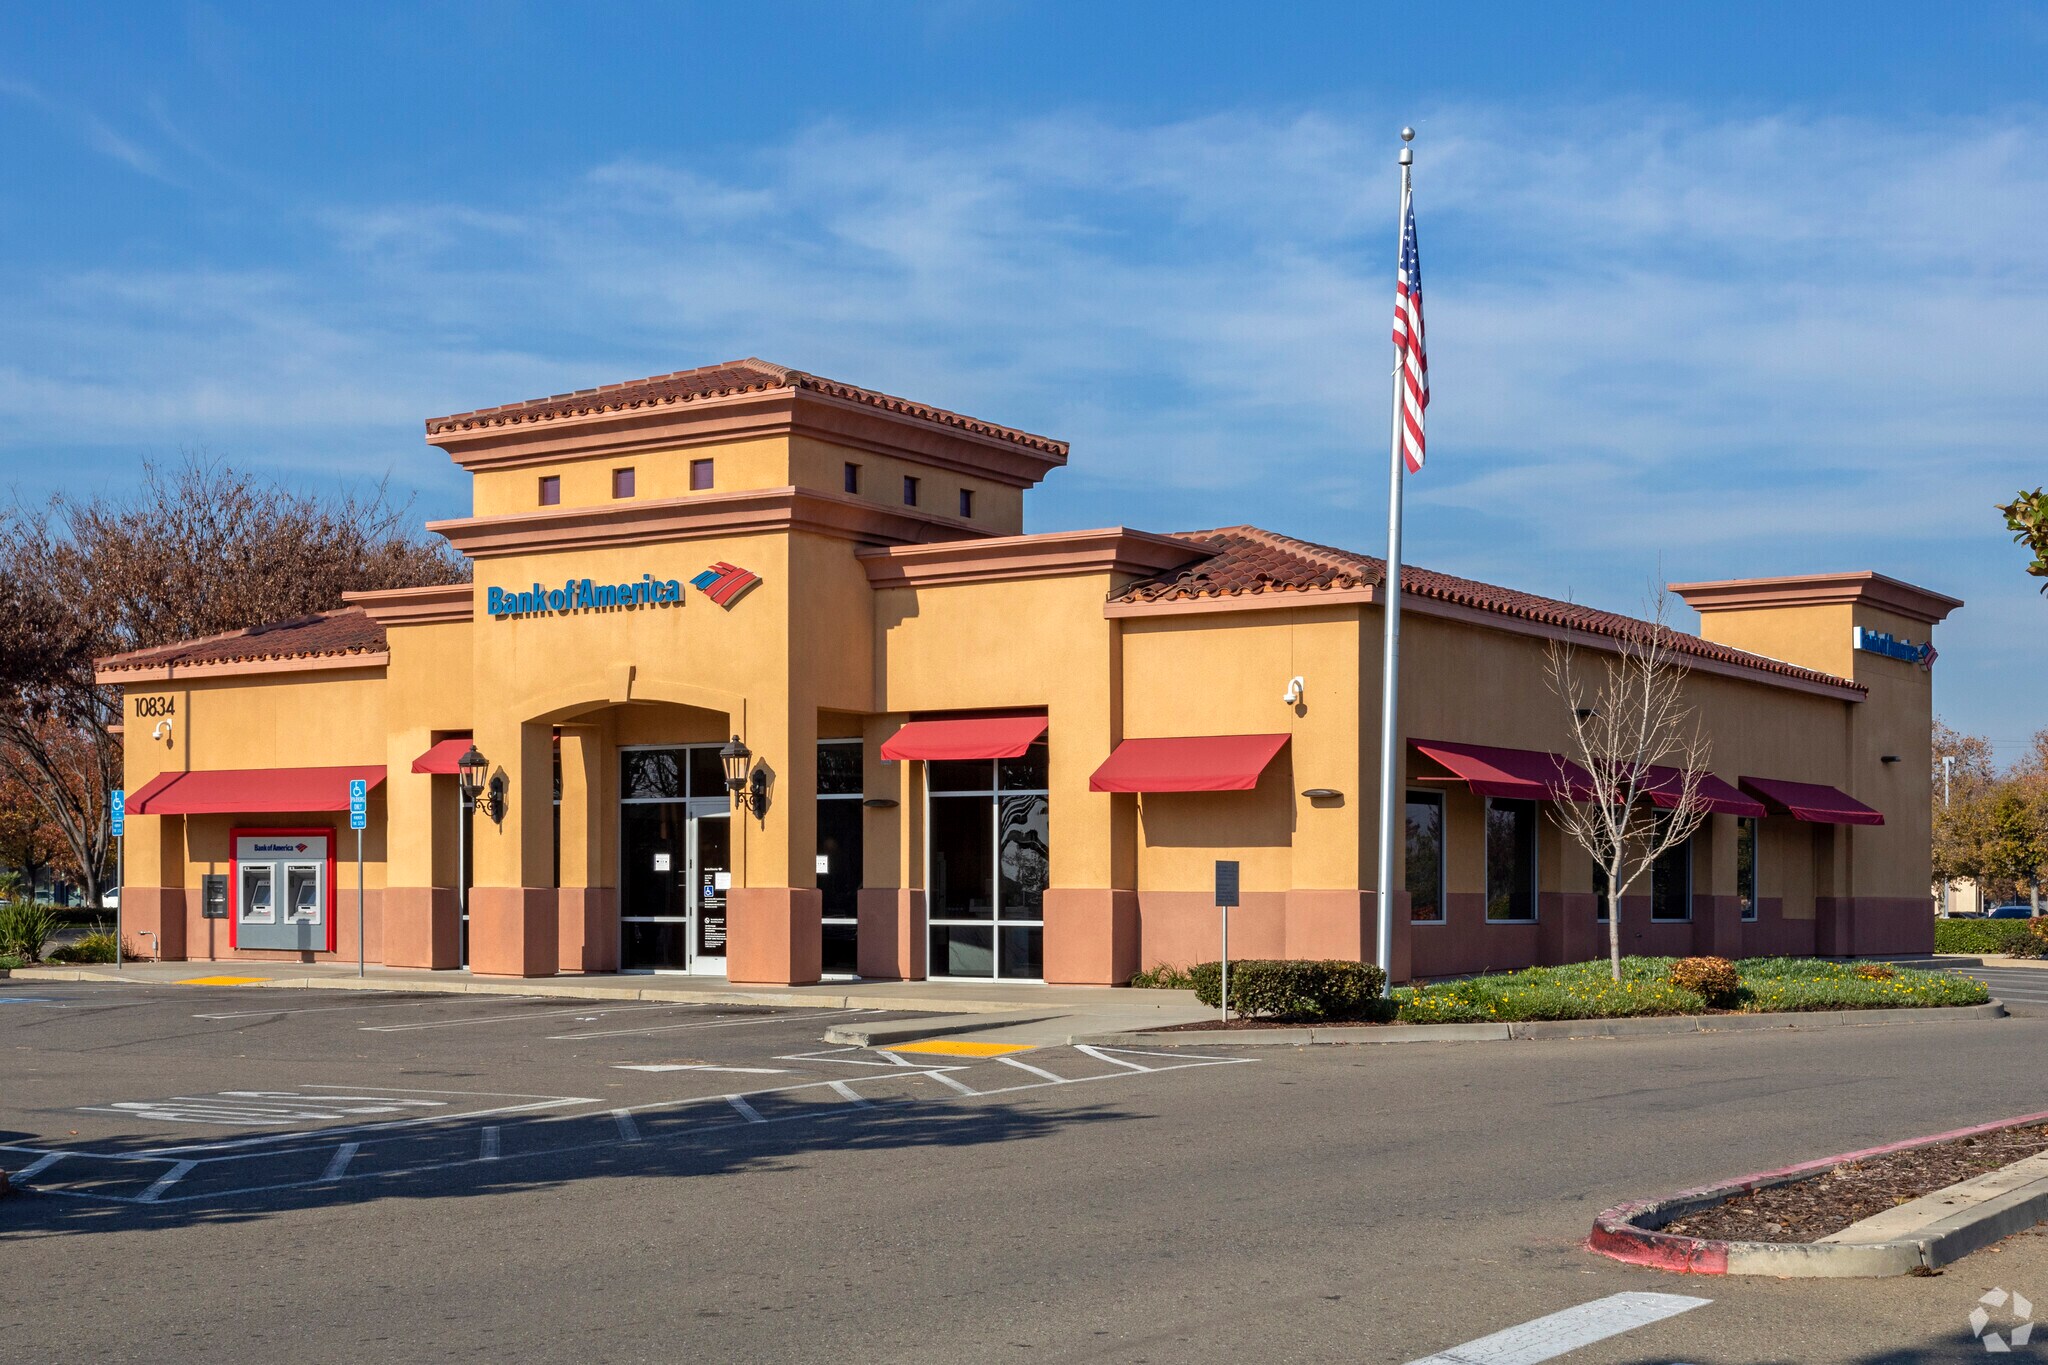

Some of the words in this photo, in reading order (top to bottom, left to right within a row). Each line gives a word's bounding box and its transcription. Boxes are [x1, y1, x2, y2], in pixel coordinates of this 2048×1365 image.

[488, 583, 547, 615] Bank
[549, 580, 577, 611] of
[577, 573, 681, 609] America
[134, 695, 175, 718] 10834
[254, 843, 267, 853] Bank
[273, 843, 293, 853] America
